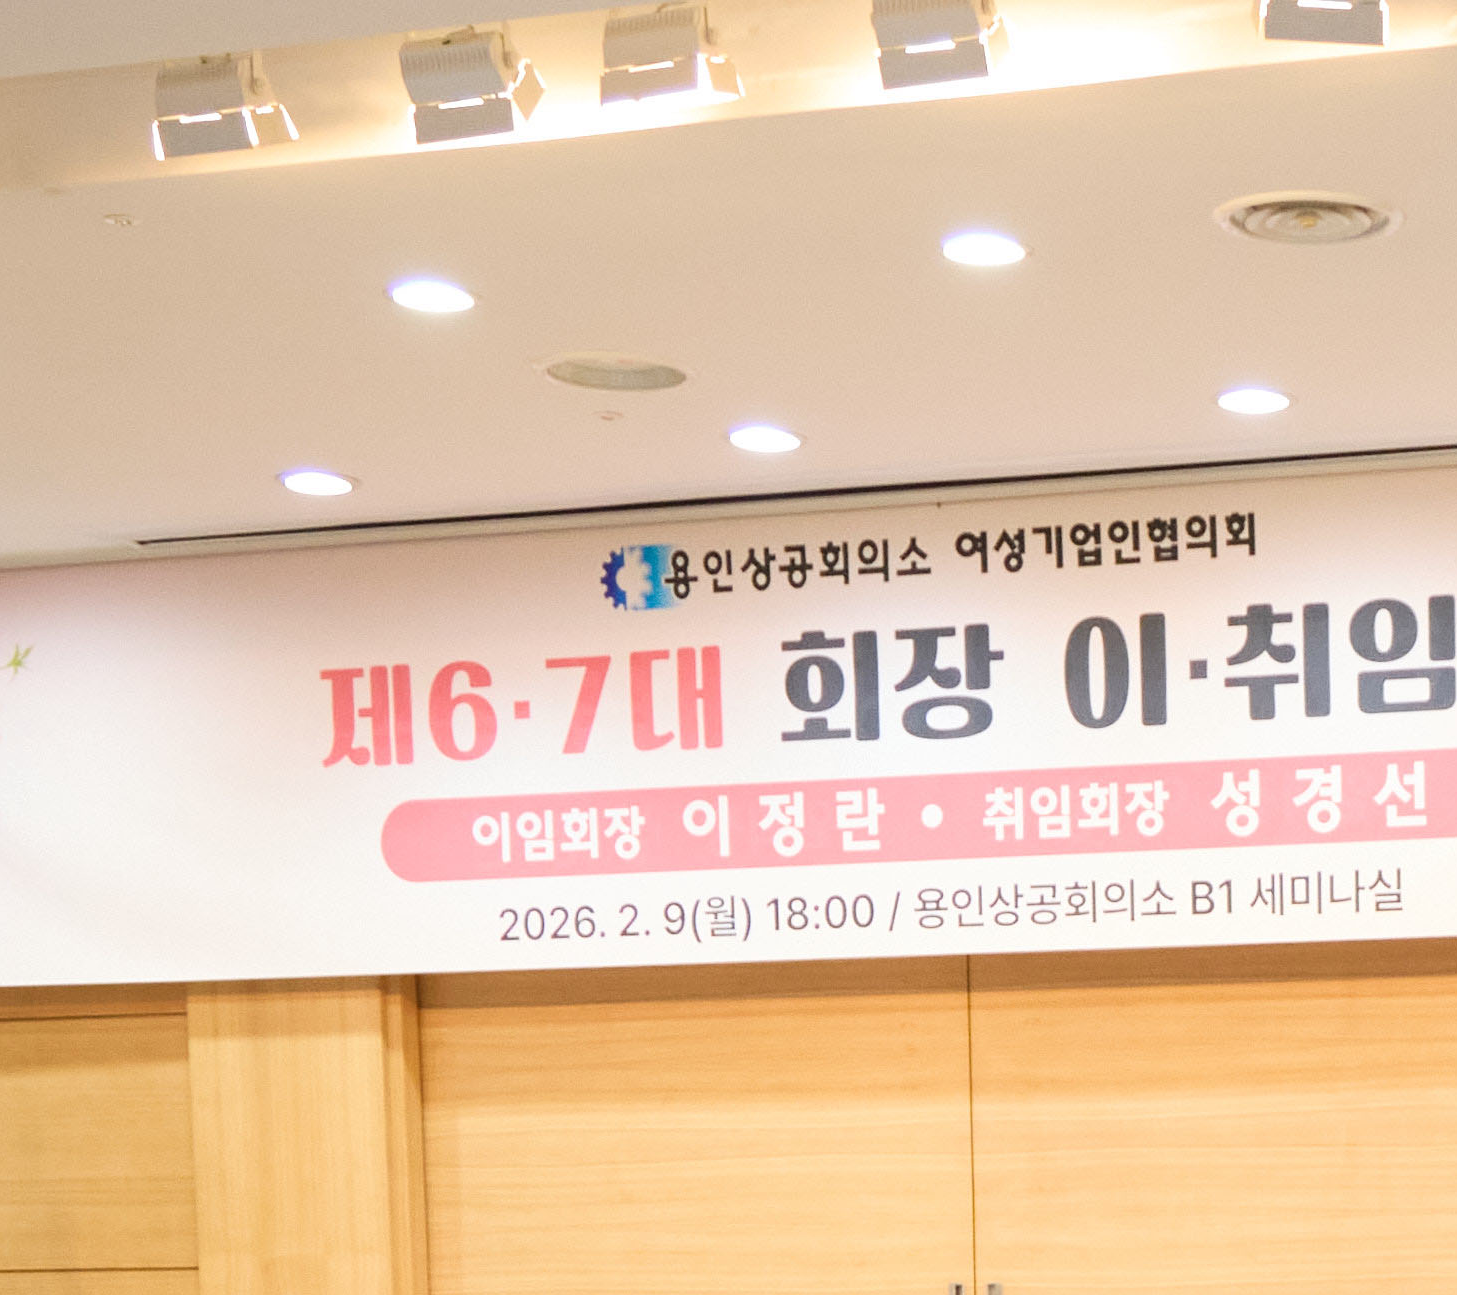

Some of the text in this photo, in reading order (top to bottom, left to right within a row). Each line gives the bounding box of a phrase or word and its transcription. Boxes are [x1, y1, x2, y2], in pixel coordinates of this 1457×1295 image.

[664, 511, 1259, 599] 용인상공회의소 여성기업인협의회
[319, 643, 725, 768] 제6·7대
[780, 621, 1004, 742] 회장
[470, 802, 646, 865] 이임회장
[981, 778, 1170, 844] 취임회장
[499, 902, 607, 942] 2026.
[664, 893, 754, 944] 9(월)
[766, 892, 876, 932] 18:00
[912, 881, 1179, 932] 용인상공회의소
[1191, 879, 1236, 917] B1
[1248, 866, 1406, 918] 세미나실
